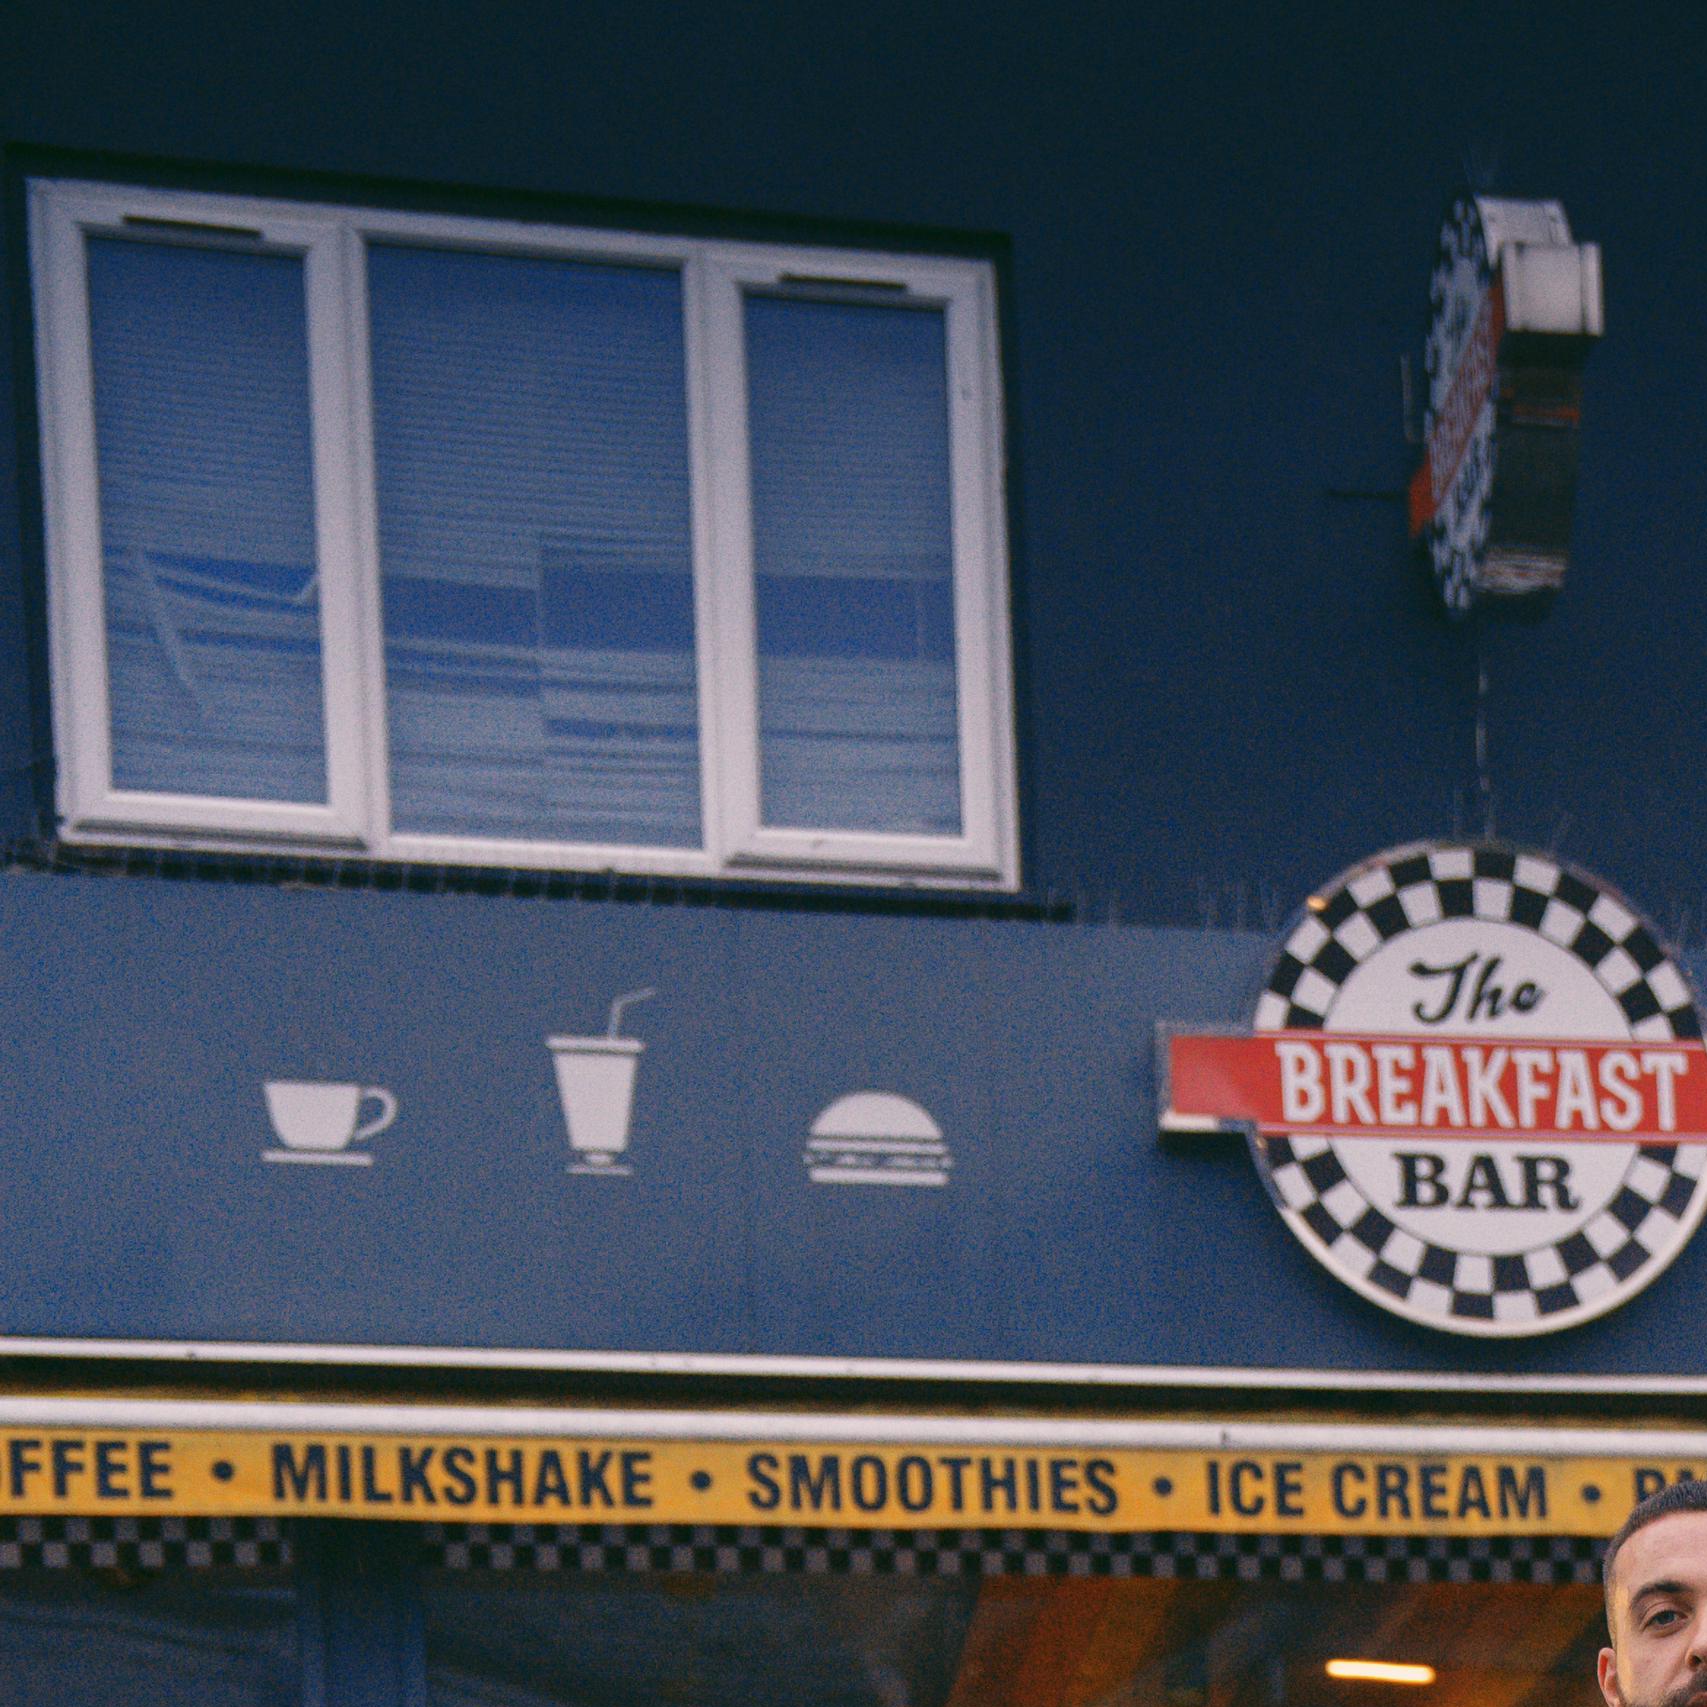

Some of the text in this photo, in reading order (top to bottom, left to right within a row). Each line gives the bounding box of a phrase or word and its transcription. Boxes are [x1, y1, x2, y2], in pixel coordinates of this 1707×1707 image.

[1409, 951, 1547, 1024] The
[1275, 1041, 1688, 1133] BREAKFAST
[1393, 1151, 1580, 1212] BAR
[0, 1438, 175, 1500] FFEE
[271, 1443, 654, 1508] MILKSHAKE
[746, 1452, 1121, 1514] SMOOTHIES
[1206, 1459, 1306, 1518] ICE
[1331, 1461, 1550, 1520] CREAM
